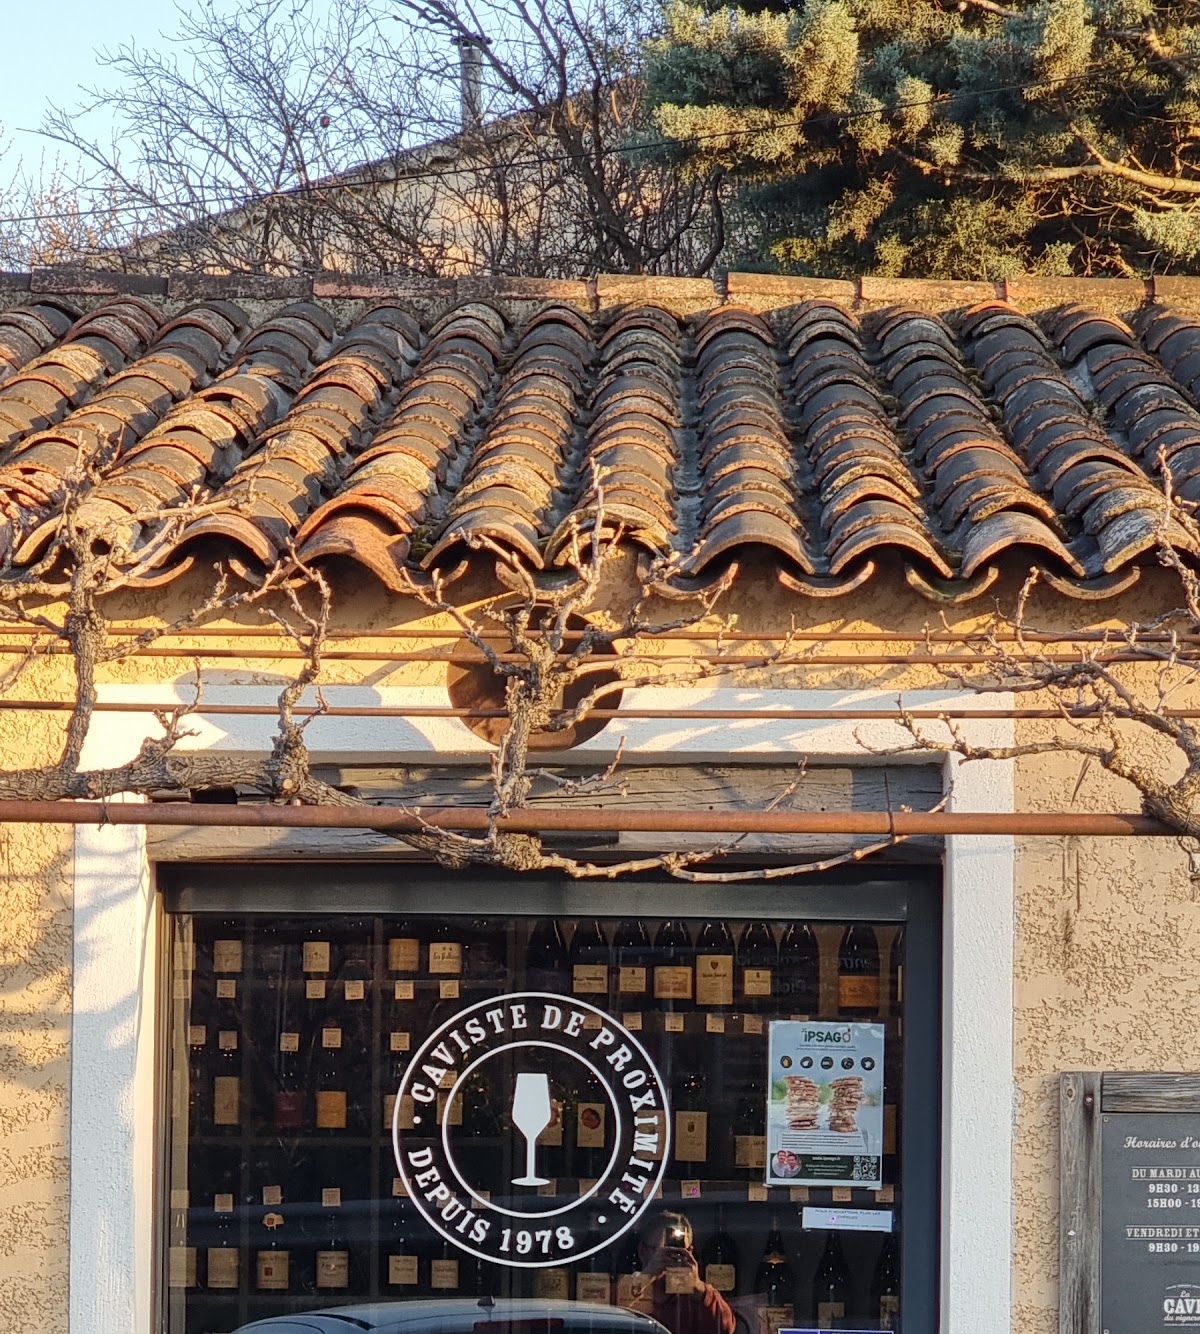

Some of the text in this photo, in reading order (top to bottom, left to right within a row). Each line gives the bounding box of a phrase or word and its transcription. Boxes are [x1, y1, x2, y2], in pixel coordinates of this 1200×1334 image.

[411, 1004, 658, 1215] CAVISTE DE PROXIMITÉ
[1123, 1136, 1200, 1149] Horaires d'o
[1132, 1168, 1200, 1178] DU MARDI AU
[1148, 1183, 1178, 1194] 9H30
[1187, 1183, 1200, 1194] 13
[408, 1147, 575, 1254] DEPUIS 1978
[1147, 1198, 1182, 1208] 15H00
[1126, 1228, 1200, 1238] VENDREDI ET
[1148, 1242, 1178, 1253] 9H30
[1187, 1242, 1200, 1253] 19
